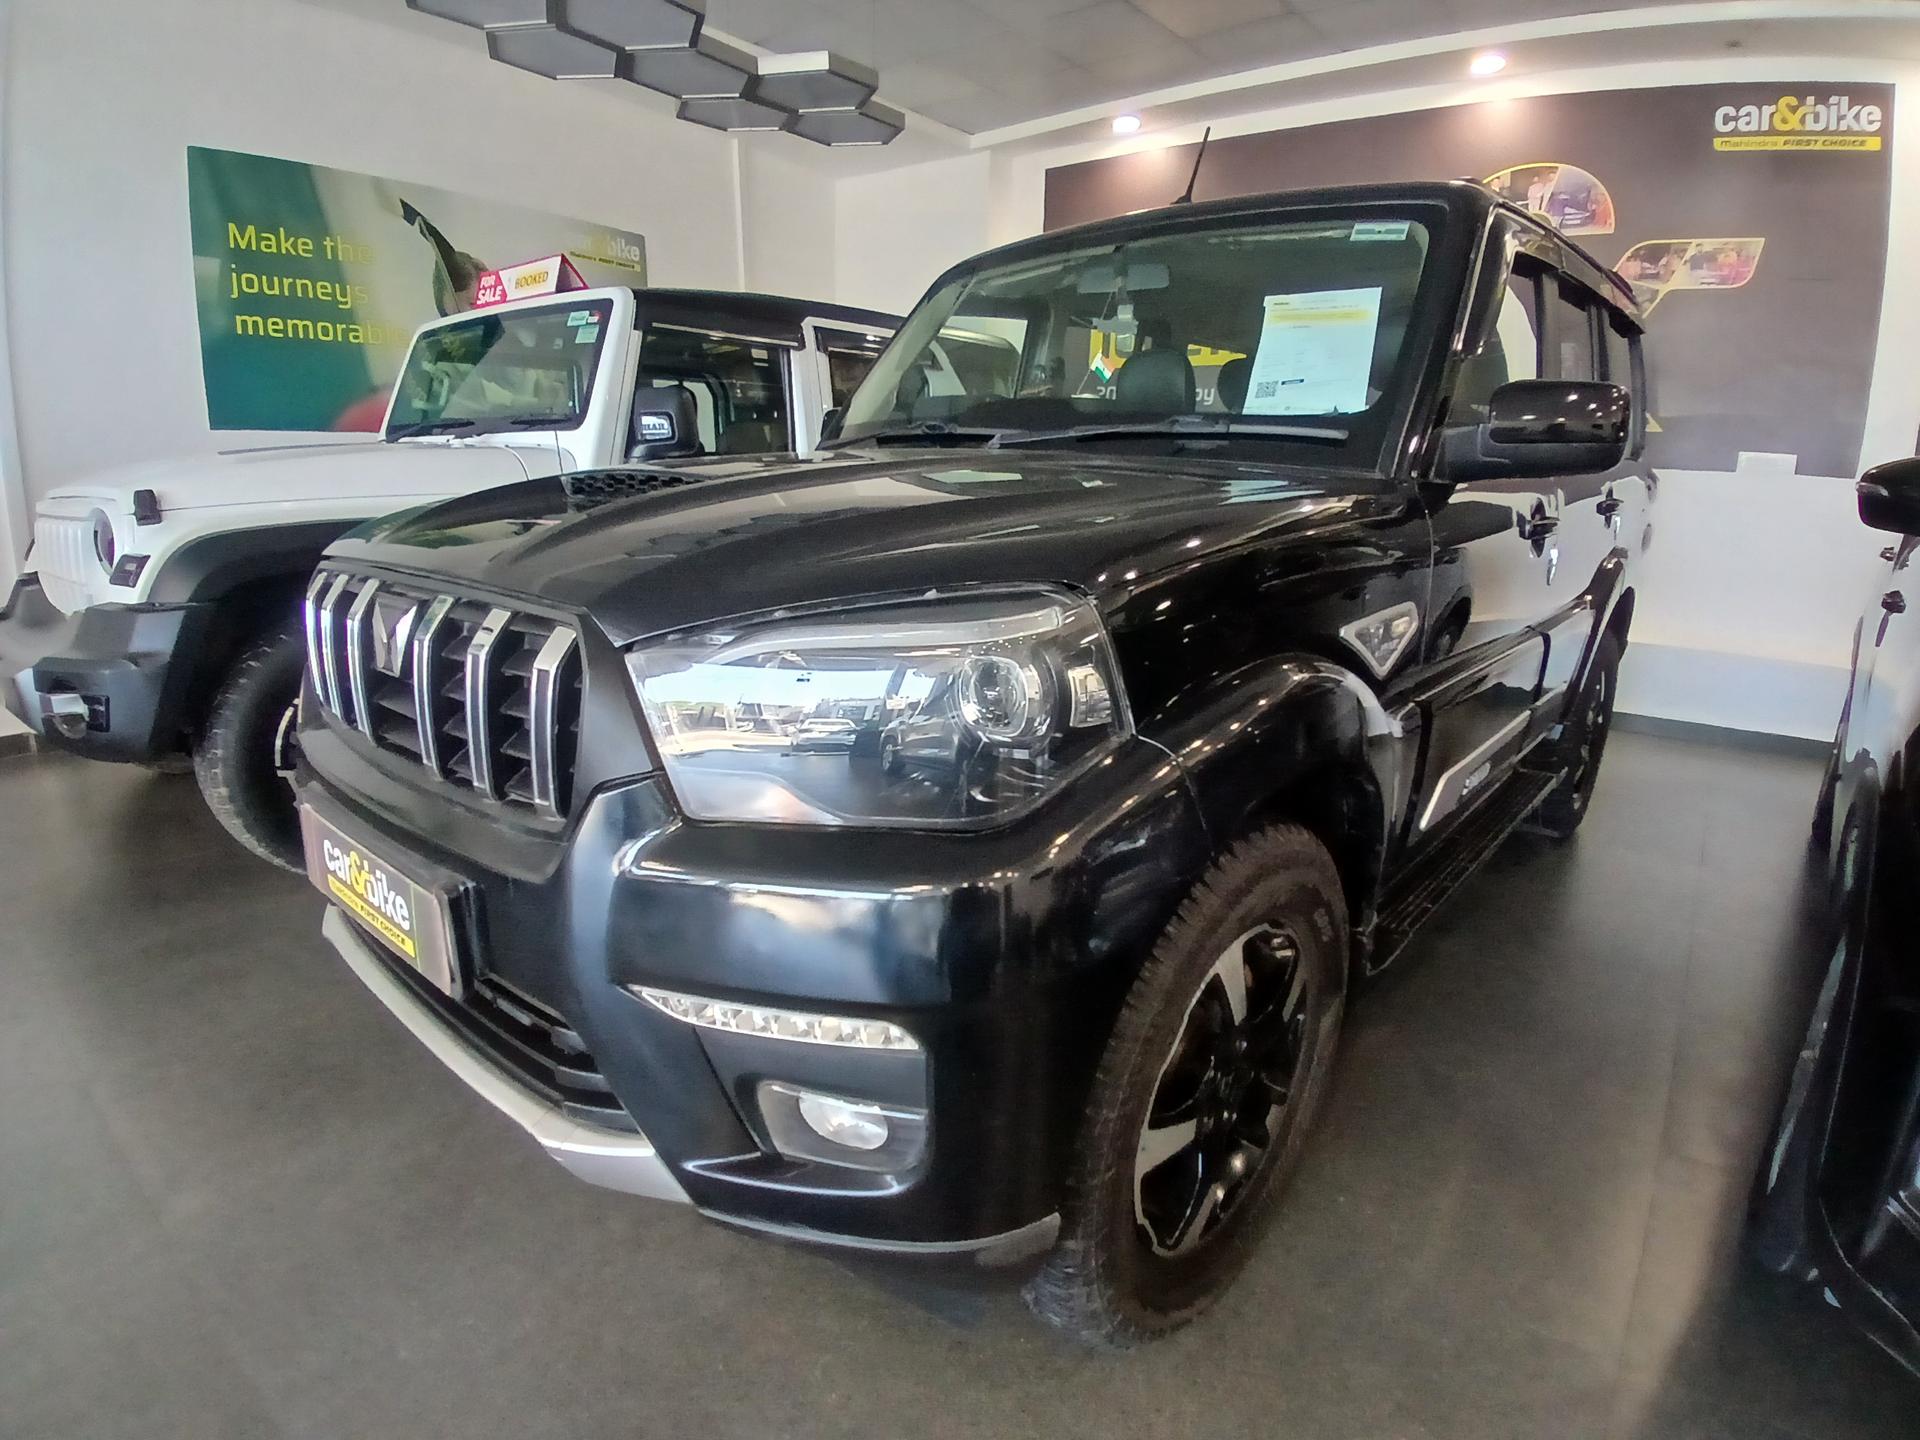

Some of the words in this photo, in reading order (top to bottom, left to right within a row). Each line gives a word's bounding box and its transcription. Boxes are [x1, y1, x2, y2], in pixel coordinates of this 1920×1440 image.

[1714, 95, 1882, 133] car&bike
[1783, 138, 1819, 147] FIRST
[1822, 138, 1868, 147] CHOICE
[228, 223, 314, 258] Make
[323, 235, 374, 264] the
[230, 264, 368, 309] journeys
[477, 286, 503, 305] SALE
[480, 275, 496, 287] FOR
[324, 839, 410, 931] car&bike
